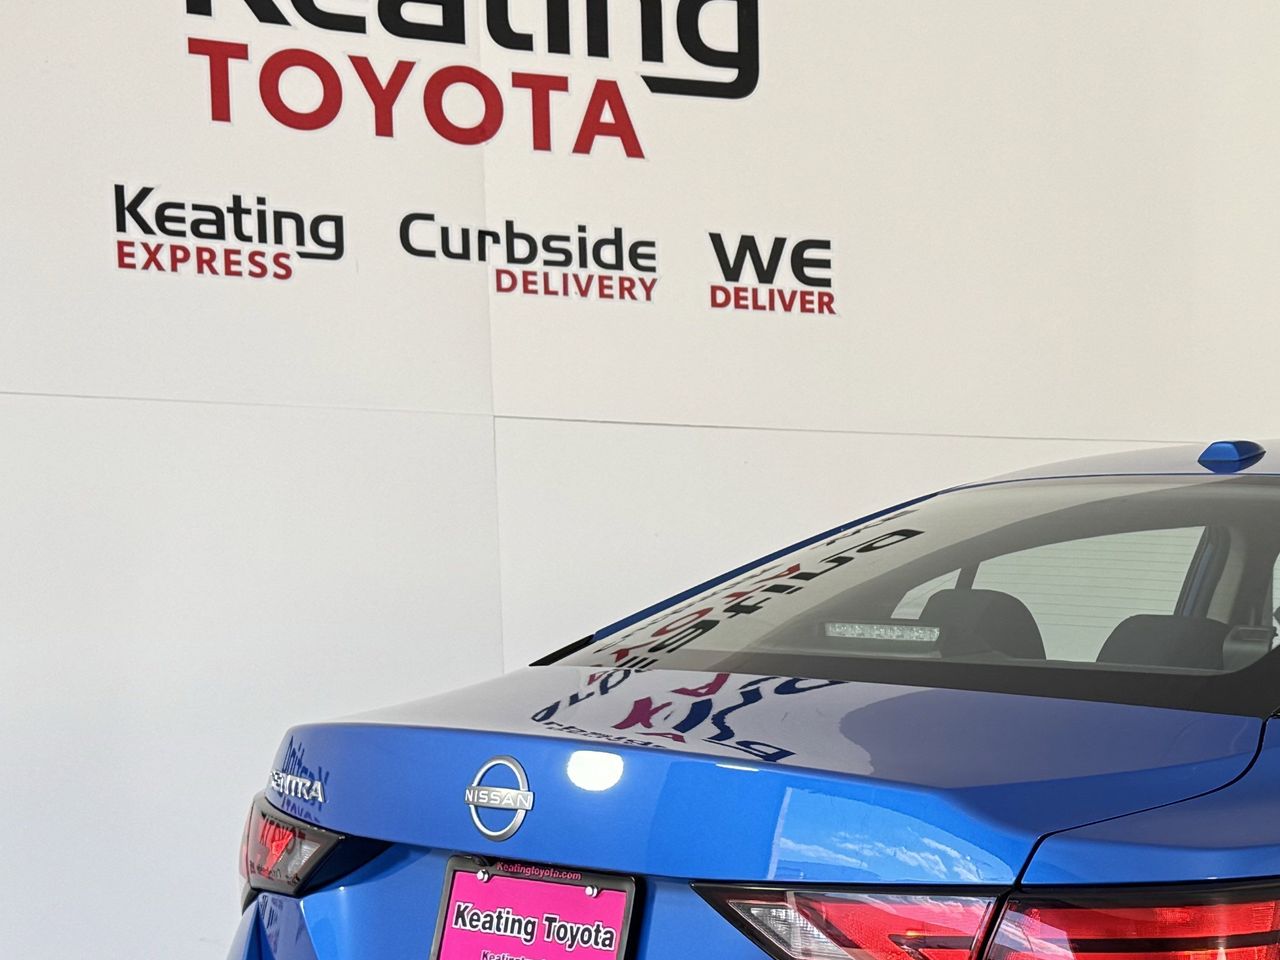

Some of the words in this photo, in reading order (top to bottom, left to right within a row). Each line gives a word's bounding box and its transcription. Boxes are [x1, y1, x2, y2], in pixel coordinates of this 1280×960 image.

[187, 36, 645, 160] TOYOTA
[114, 183, 345, 261] Keating
[399, 212, 657, 274] Curbside
[116, 240, 294, 281] EXPRESS
[495, 268, 658, 301] DELIVERY
[708, 231, 832, 288] WE
[710, 284, 836, 315] DELIVER
[465, 789, 532, 808] NISSAN
[452, 902, 538, 946] Keating
[542, 914, 616, 955] Toyota
